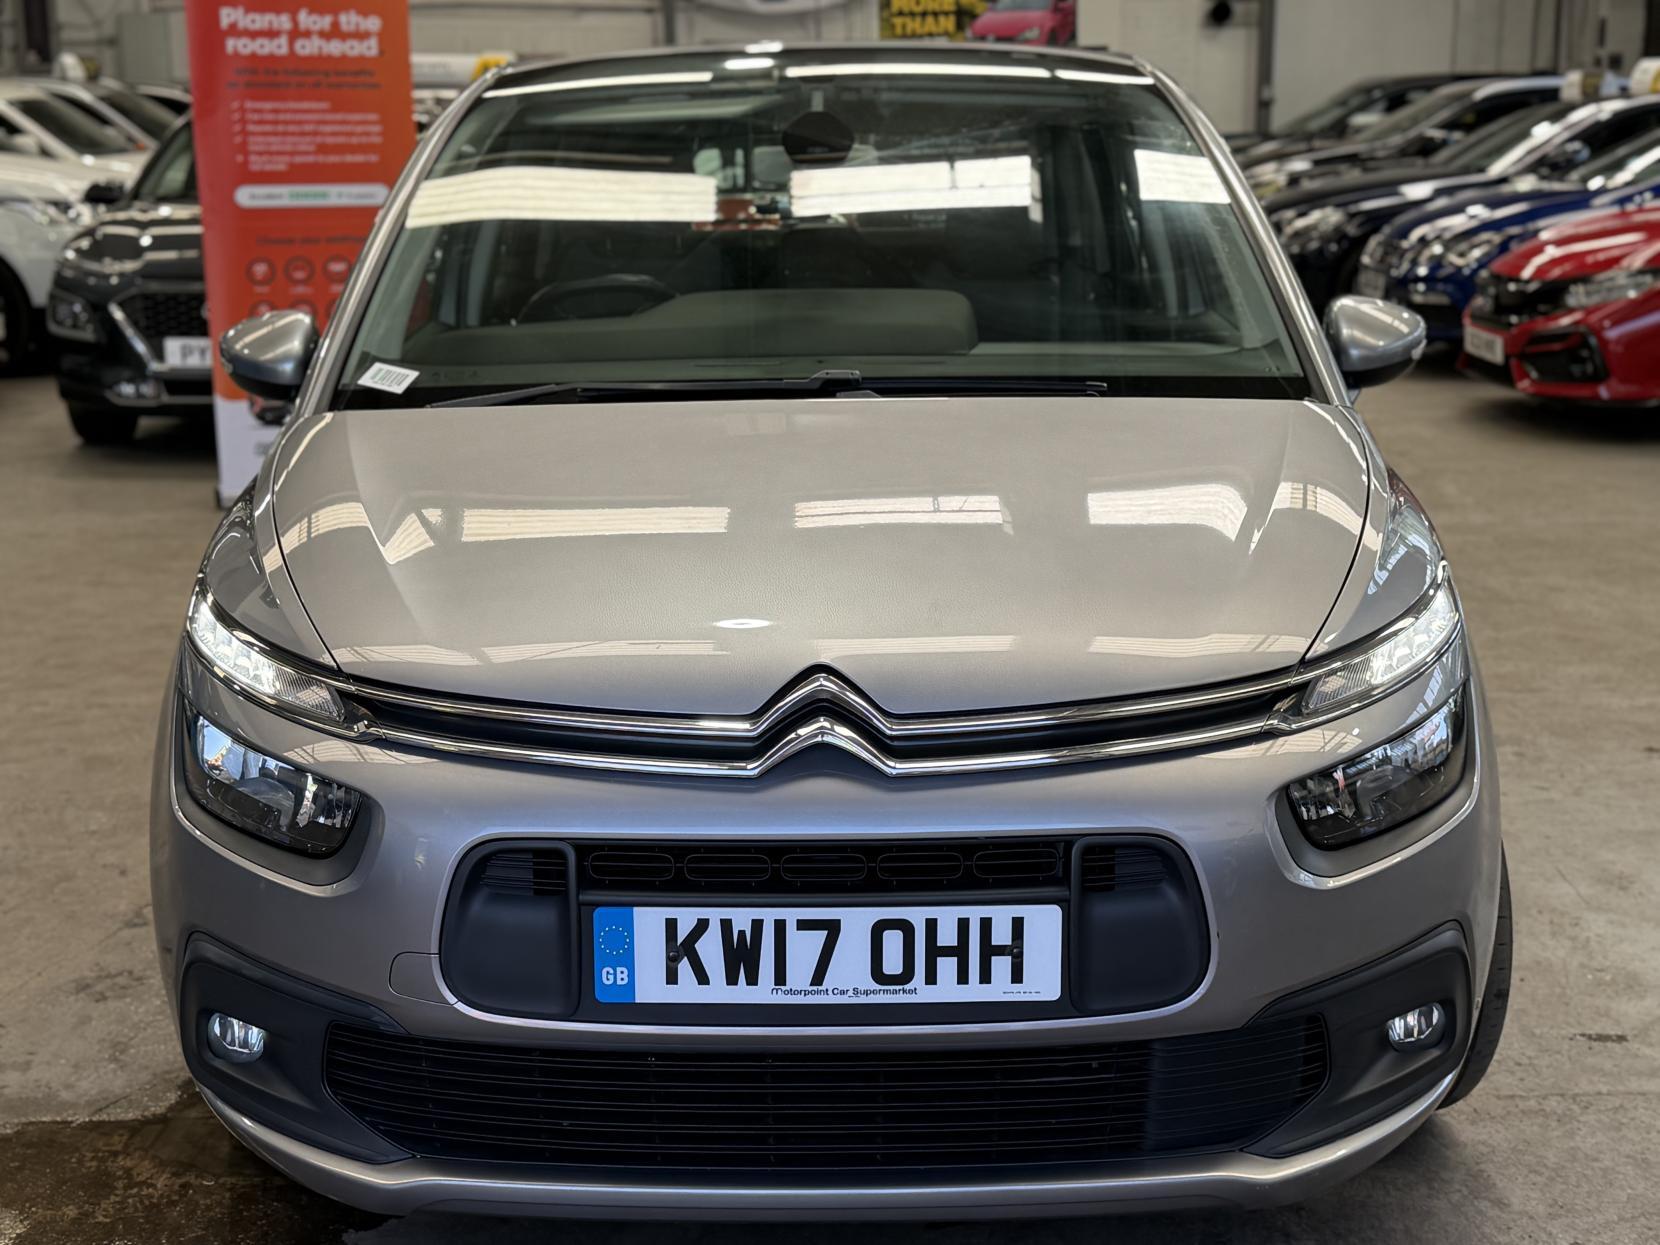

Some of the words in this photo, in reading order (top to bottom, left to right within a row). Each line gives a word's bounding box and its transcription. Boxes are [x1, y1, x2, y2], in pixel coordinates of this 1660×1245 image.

[218, 6, 293, 31] Plans
[296, 8, 334, 32] for
[338, 10, 383, 33] the
[891, 14, 957, 36] THAN
[224, 35, 289, 56] road
[665, 917, 841, 987] KW17
[870, 916, 1025, 987] OHH
[601, 967, 629, 985] GB
[770, 987, 829, 997] Motorpoint
[831, 987, 849, 997] Car
[851, 986, 919, 998] Supermarket
